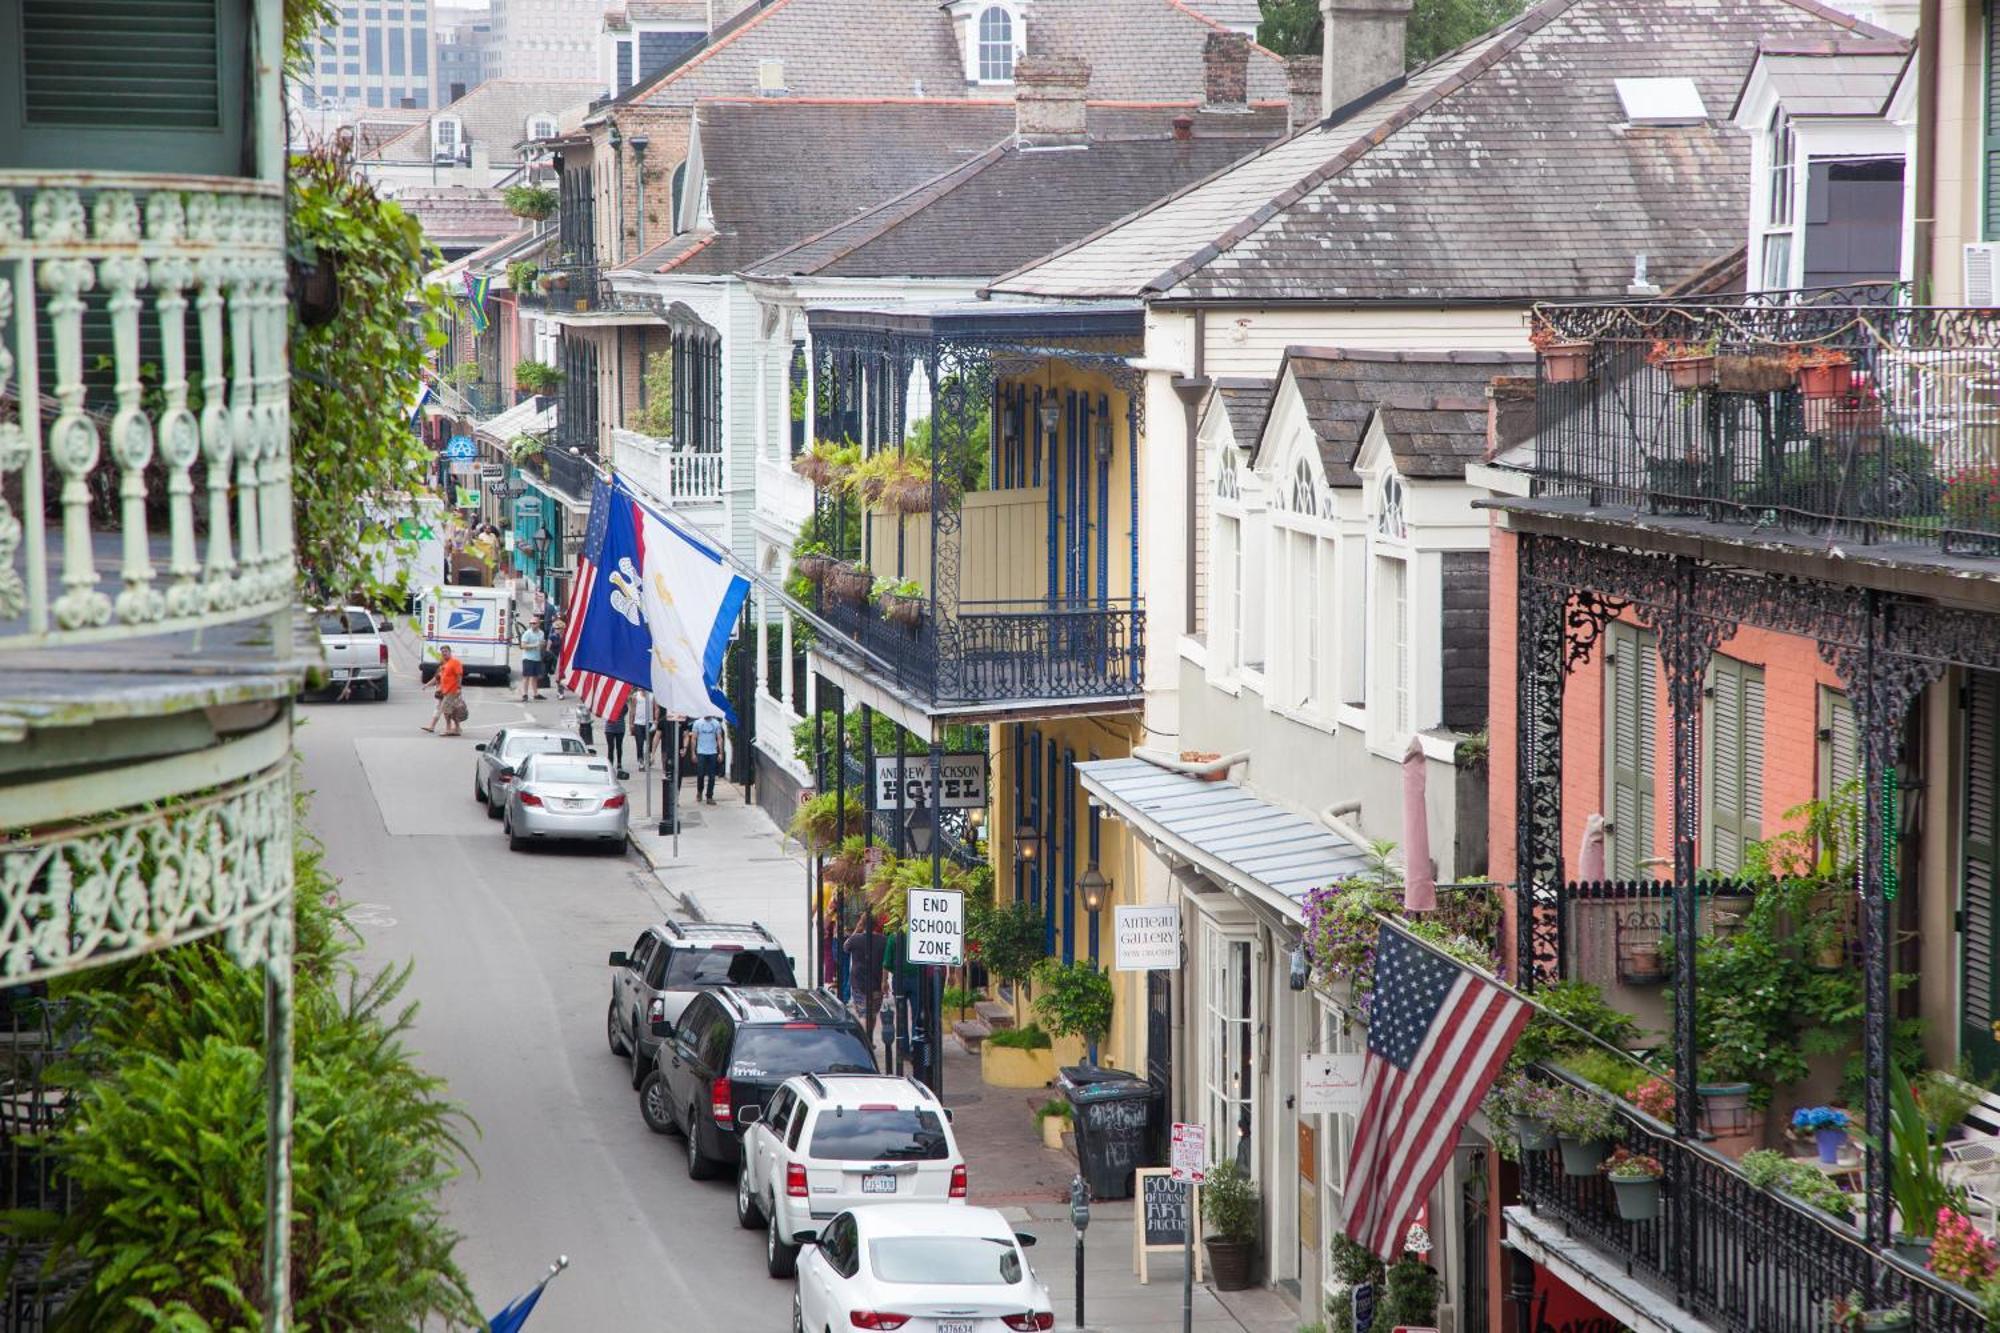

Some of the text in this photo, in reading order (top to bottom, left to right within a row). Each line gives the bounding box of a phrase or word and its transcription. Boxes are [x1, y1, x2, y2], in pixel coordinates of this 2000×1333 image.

[923, 898, 948, 913] END
[911, 918, 961, 935] SCHOOL
[918, 940, 951, 956] ZONE
[1147, 1218, 1187, 1231] AUCTIO
